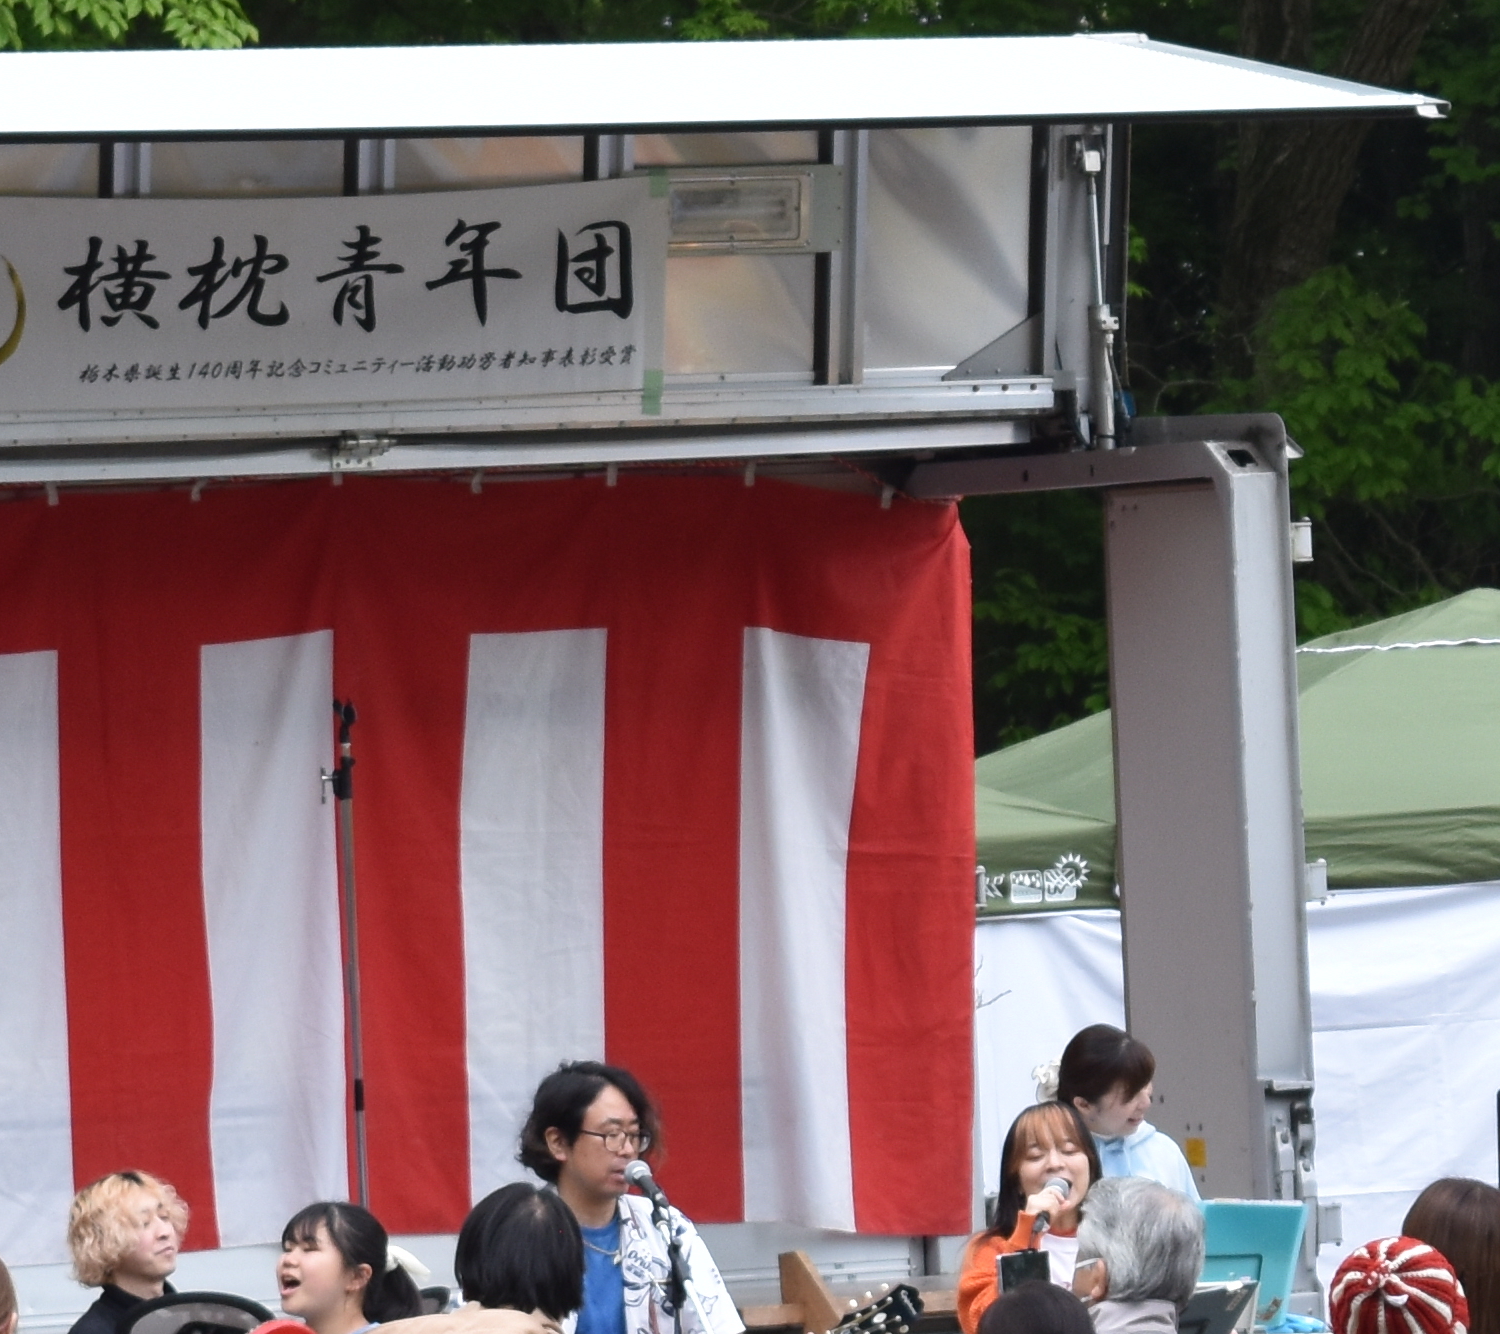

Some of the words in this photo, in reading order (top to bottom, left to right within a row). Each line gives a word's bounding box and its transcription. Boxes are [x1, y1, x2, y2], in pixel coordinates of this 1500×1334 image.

[55, 218, 634, 335] 横枕青年団
